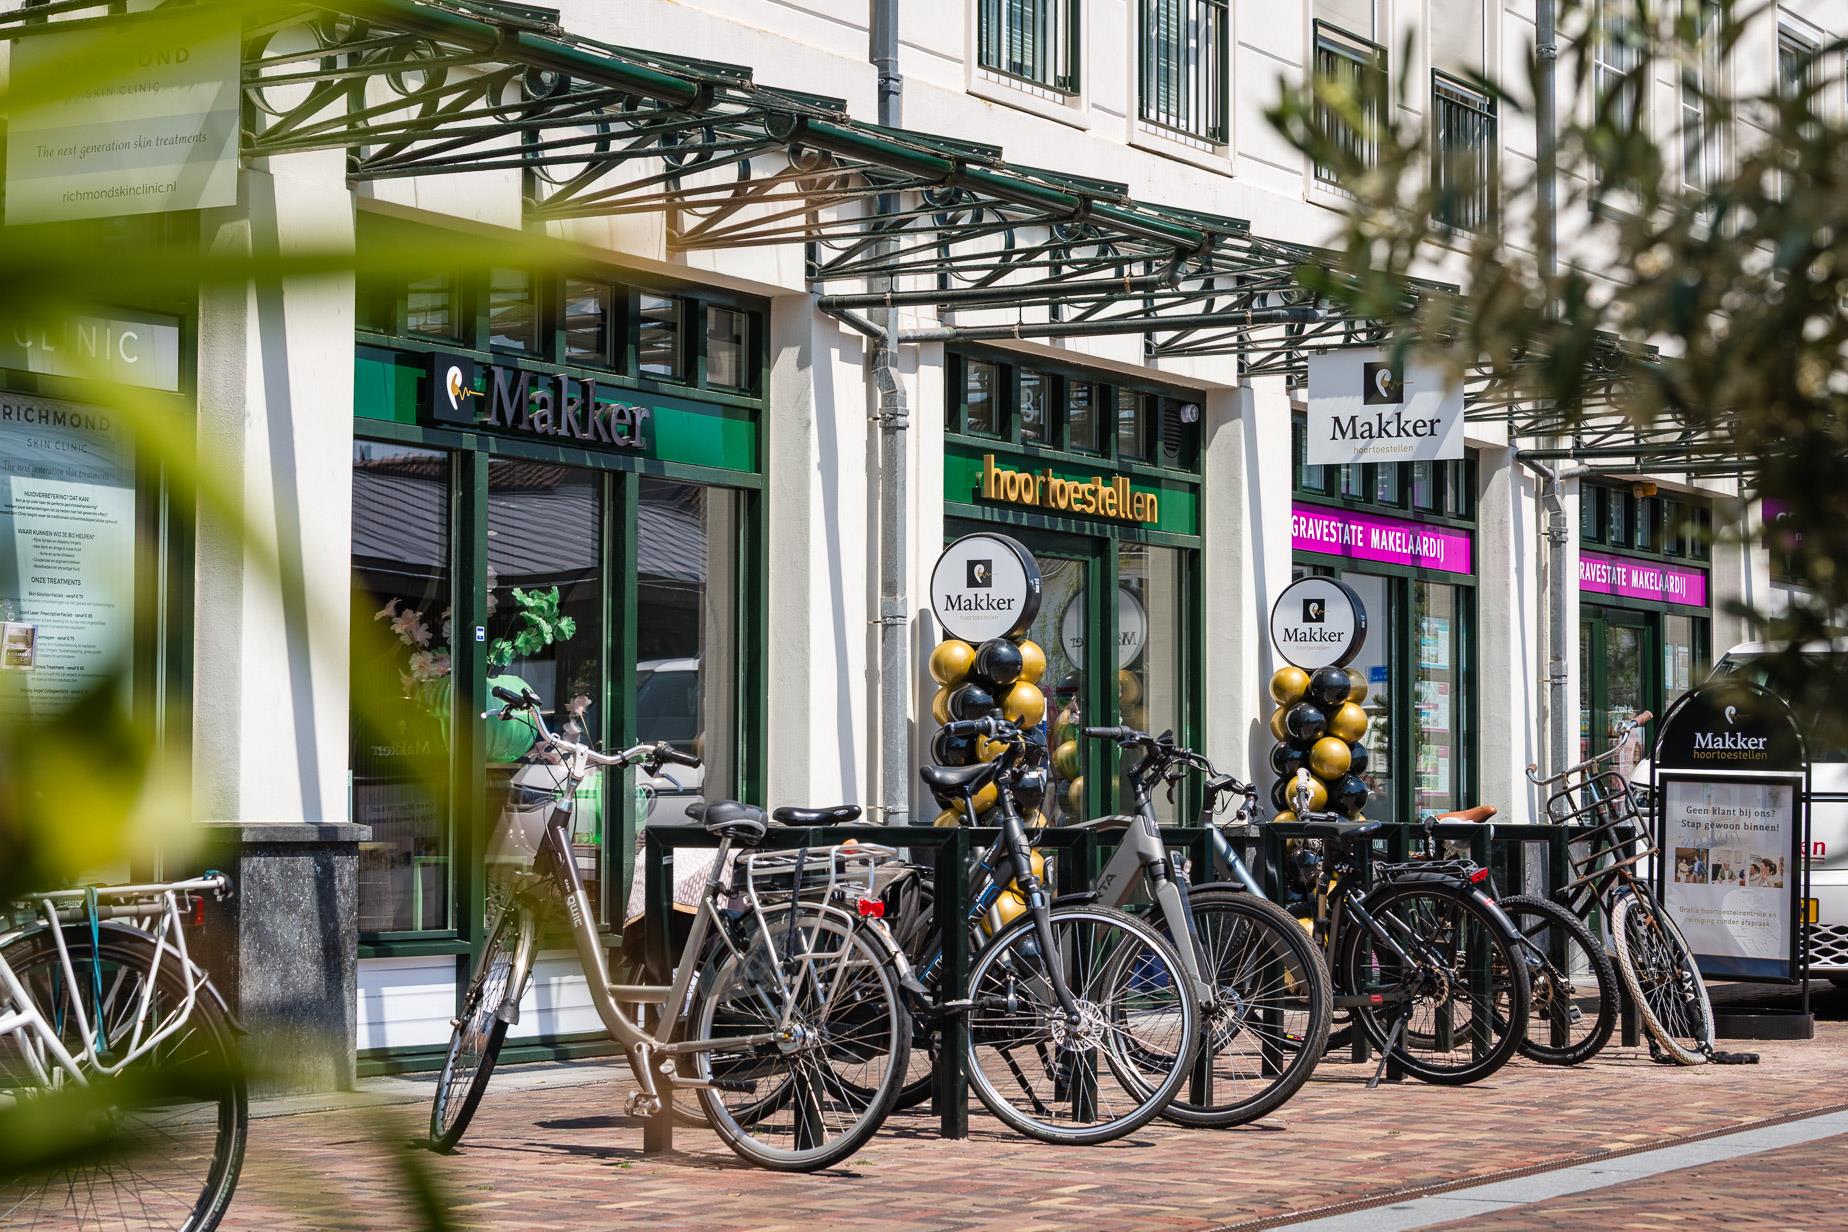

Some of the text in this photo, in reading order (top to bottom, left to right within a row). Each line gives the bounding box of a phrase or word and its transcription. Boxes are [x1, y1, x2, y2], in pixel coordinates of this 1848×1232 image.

[119, 81, 161, 96] CLINIC
[36, 132, 207, 160] The next generation skin treatments
[62, 181, 178, 203] richmondskinclinic.nl
[480, 364, 650, 450] Makker
[1023, 388, 1045, 425] 31
[2, 404, 111, 432] RICHMOND
[1329, 411, 1442, 441] Makker
[26, 438, 88, 454] SKIN CLINIC
[1353, 444, 1414, 454] hoortoestellen
[983, 453, 1158, 524] hoortoestellen
[1370, 527, 1445, 562] MAKELAARDIJ
[1631, 570, 1686, 598] MAKELAARDIJ
[944, 592, 1015, 612] Makker
[1282, 626, 1345, 643] Makker
[1693, 731, 1768, 750] Makker
[1693, 750, 1768, 760] hoortoestellen
[1686, 805, 1776, 818] Geen klant bij ons?
[1681, 820, 1780, 832] Stap gewoon binnen!
[566, 895, 583, 928] QWIC
